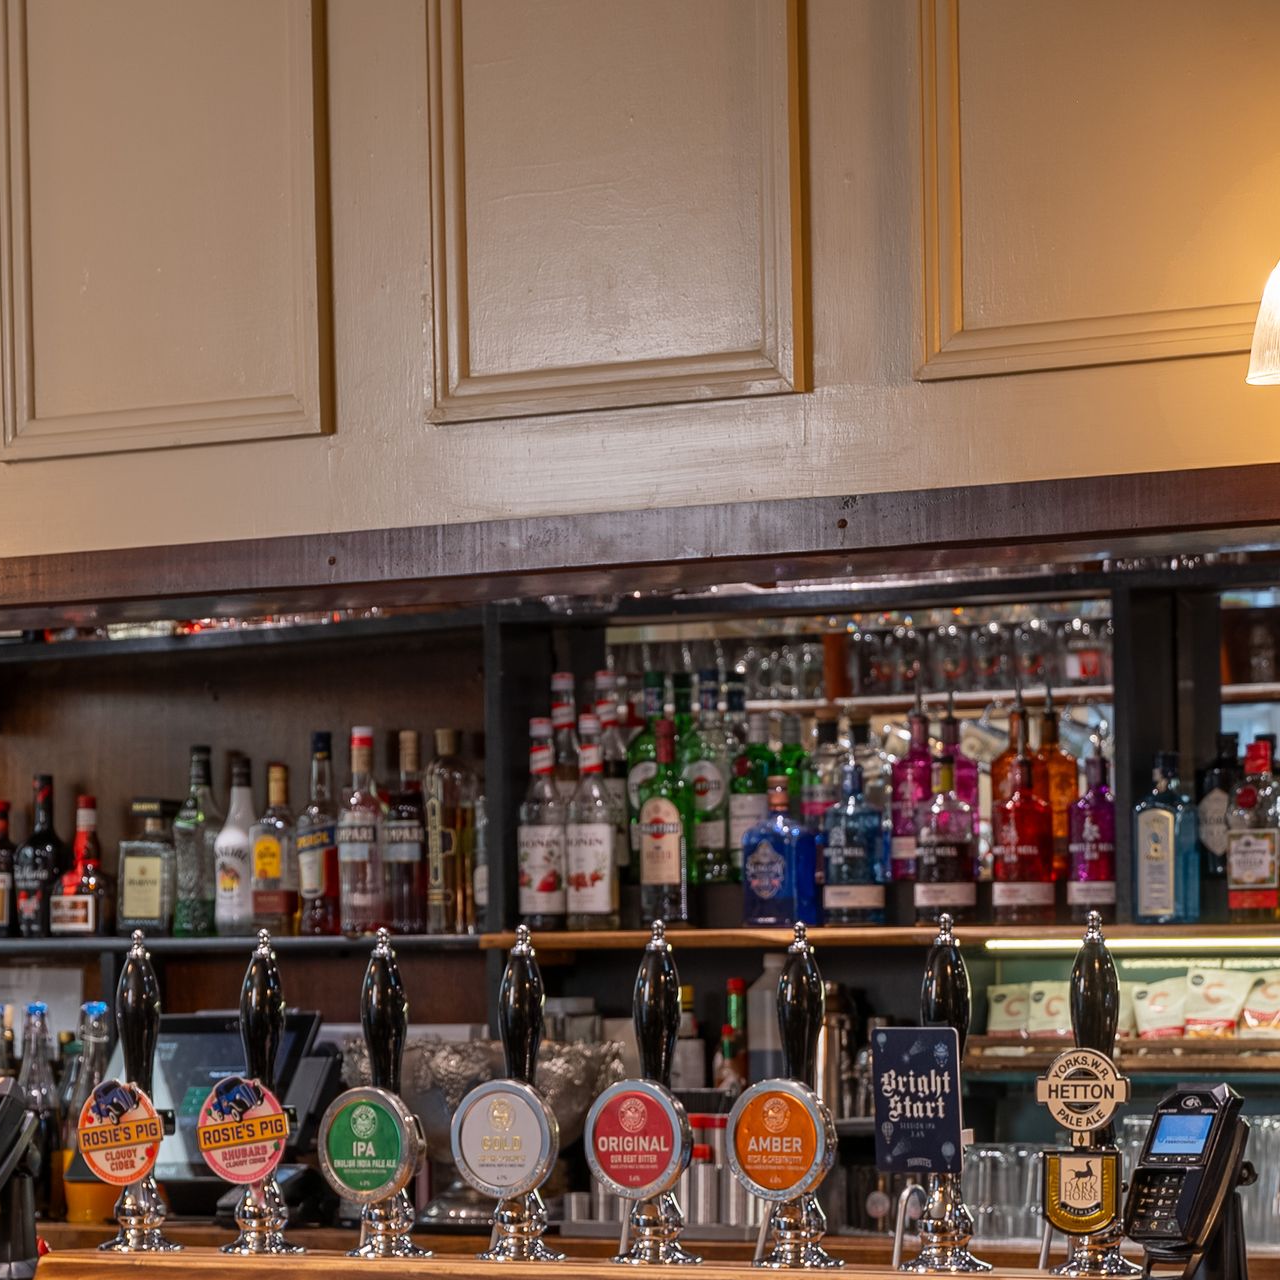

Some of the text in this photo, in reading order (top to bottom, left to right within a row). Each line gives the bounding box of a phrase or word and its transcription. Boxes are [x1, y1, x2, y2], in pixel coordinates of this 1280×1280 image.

[881, 1069, 951, 1098] Bright
[1048, 1084, 1115, 1099] HETTON
[888, 1094, 946, 1121] Start
[1057, 1108, 1106, 1127] PALE ALE
[353, 1141, 376, 1157] IPA
[481, 1135, 522, 1151] GOLD
[598, 1136, 670, 1152] ORIGINAL
[747, 1136, 803, 1153] AMBER
[105, 1148, 137, 1161] CLOUDY
[221, 1145, 268, 1161] RHUBARB
[110, 1160, 136, 1171] CIDER
[1064, 1182, 1098, 1193] DARK
[1064, 1191, 1099, 1201] HORSE
